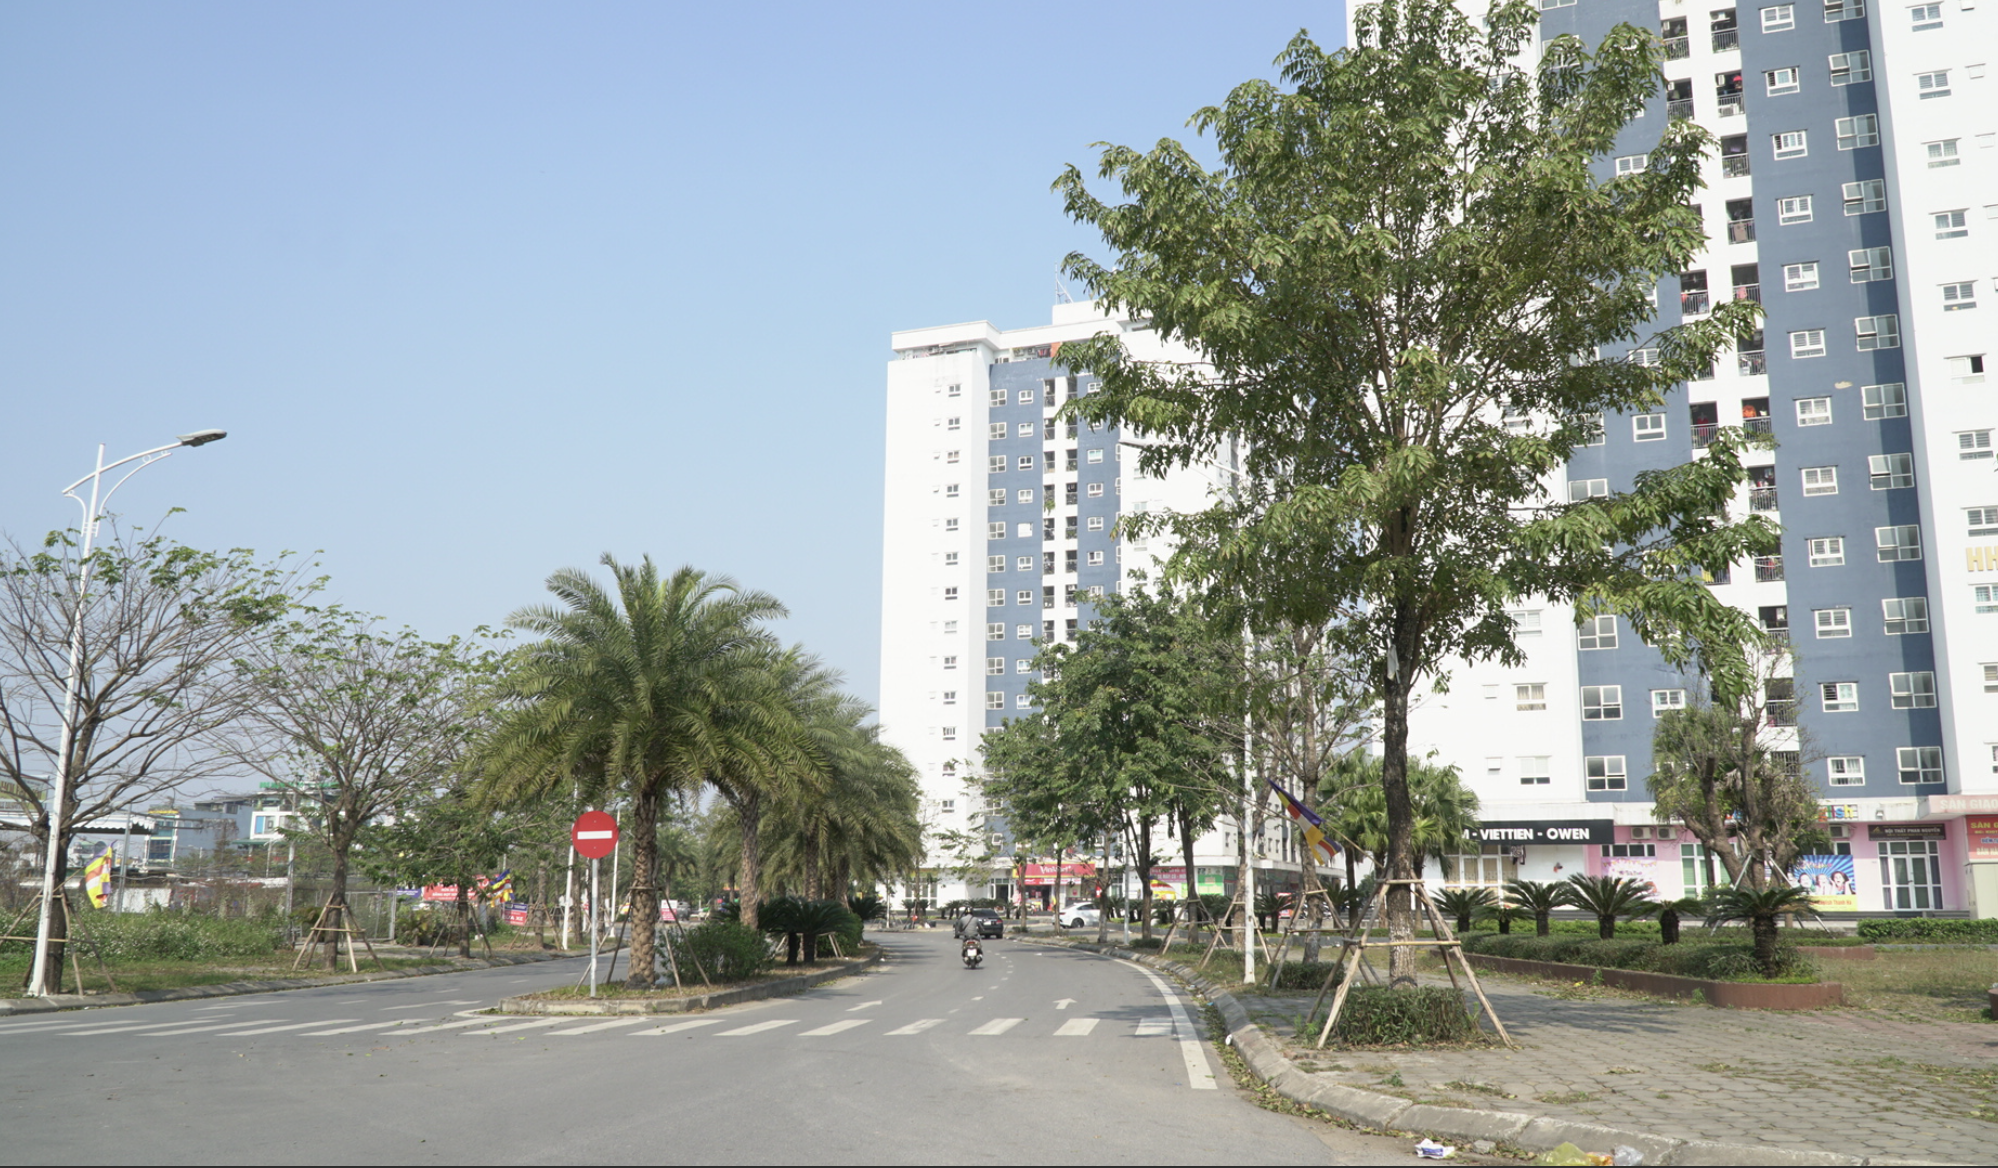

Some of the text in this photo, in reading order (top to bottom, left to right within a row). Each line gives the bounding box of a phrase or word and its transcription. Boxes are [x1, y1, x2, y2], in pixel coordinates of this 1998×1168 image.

[1940, 798, 1998, 810] SÀN GIAO
[1479, 828, 1534, 840] VIETTIEN
[1546, 827, 1590, 840] OWEN
